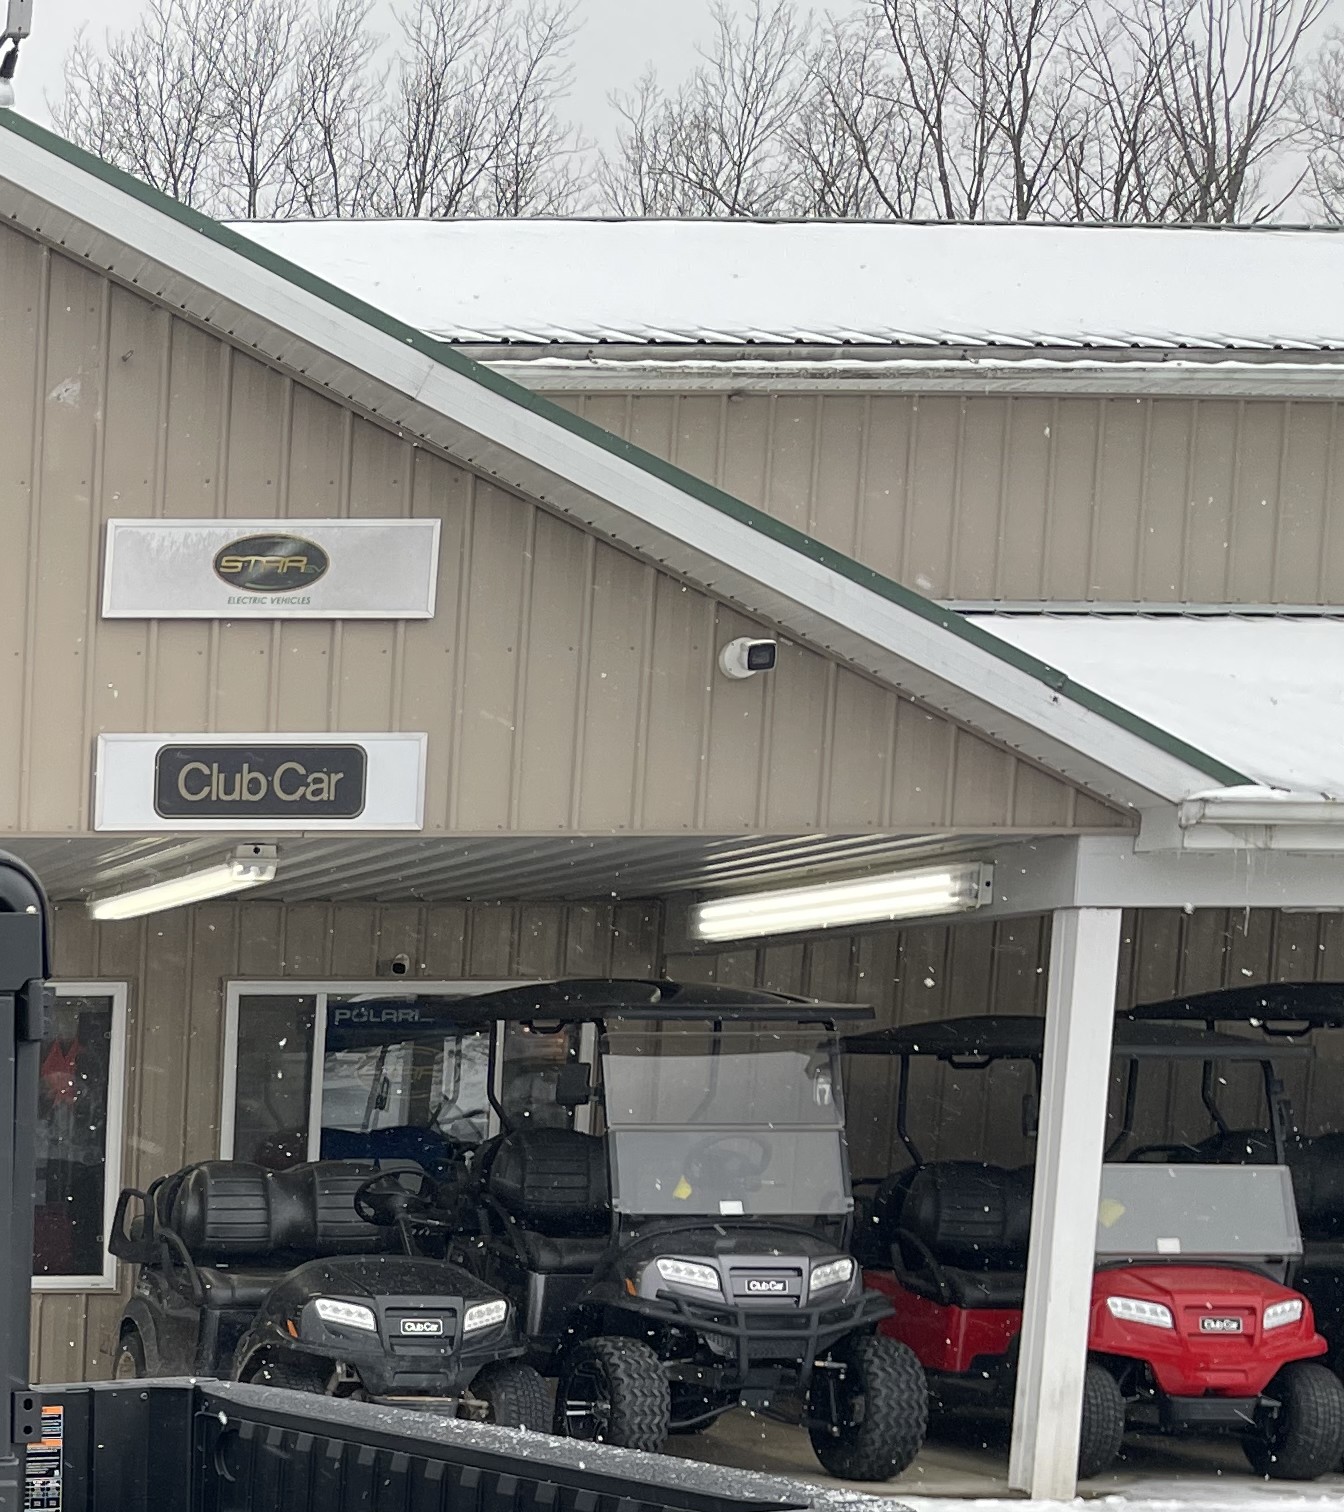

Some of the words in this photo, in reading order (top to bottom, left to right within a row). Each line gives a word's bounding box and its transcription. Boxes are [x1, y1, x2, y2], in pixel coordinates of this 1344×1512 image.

[220, 556, 309, 574] STAR
[227, 596, 268, 605] ELECTRIC
[270, 596, 311, 606] VEHICLES
[177, 761, 268, 802] Club
[272, 761, 344, 802] Car
[334, 1008, 435, 1024] POLARI
